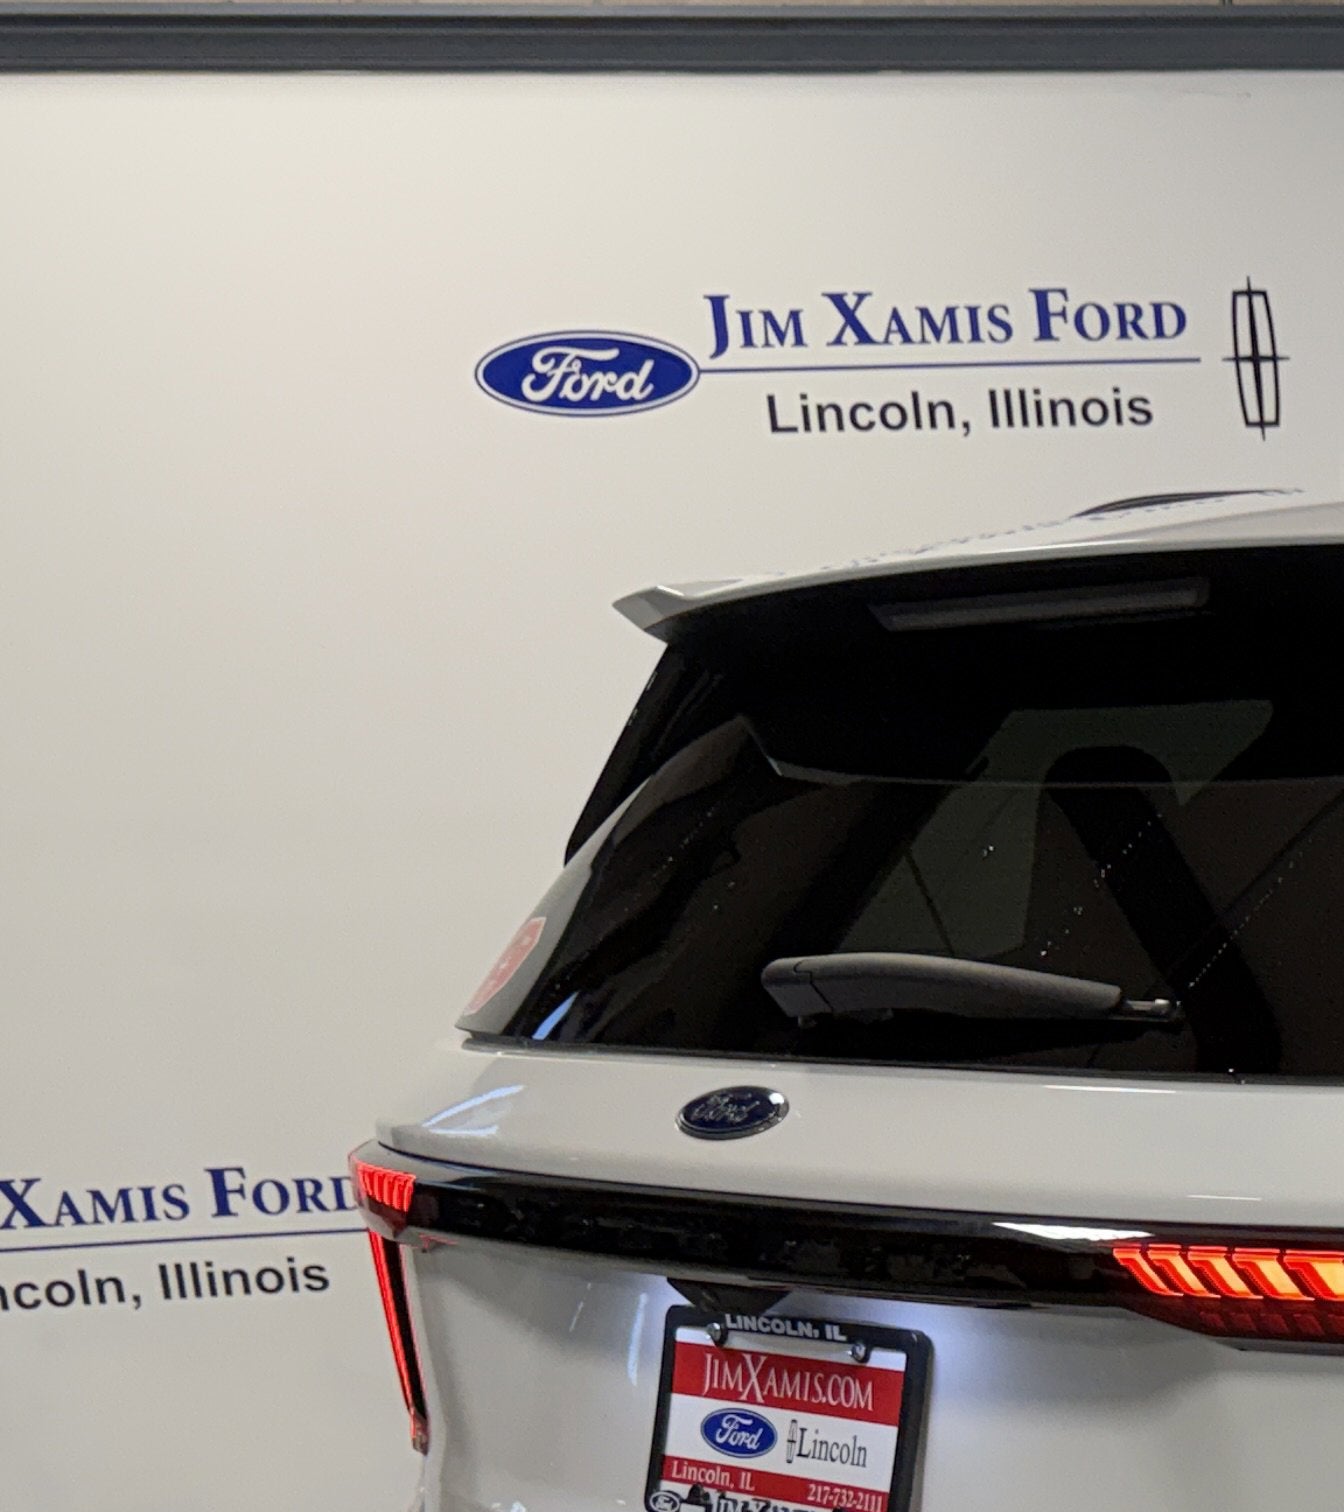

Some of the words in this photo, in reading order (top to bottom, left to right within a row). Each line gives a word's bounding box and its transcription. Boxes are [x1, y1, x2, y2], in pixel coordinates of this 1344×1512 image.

[704, 294, 805, 360] JIM
[822, 291, 1014, 346] XAMIS
[1028, 288, 1187, 342] FORD
[522, 346, 653, 402] Ford
[769, 391, 972, 438] Lincoln,
[989, 387, 1154, 430] Illinois
[0, 1177, 190, 1229] XAMIS
[158, 1256, 329, 1299] Illinois
[725, 1314, 820, 1339] LINCOLN,
[825, 1325, 847, 1341] IL
[715, 1414, 762, 1450] Ford
[797, 1427, 867, 1468] Lincoln
[740, 1472, 755, 1491] IL
[807, 1484, 882, 1512] 217-732-2111
